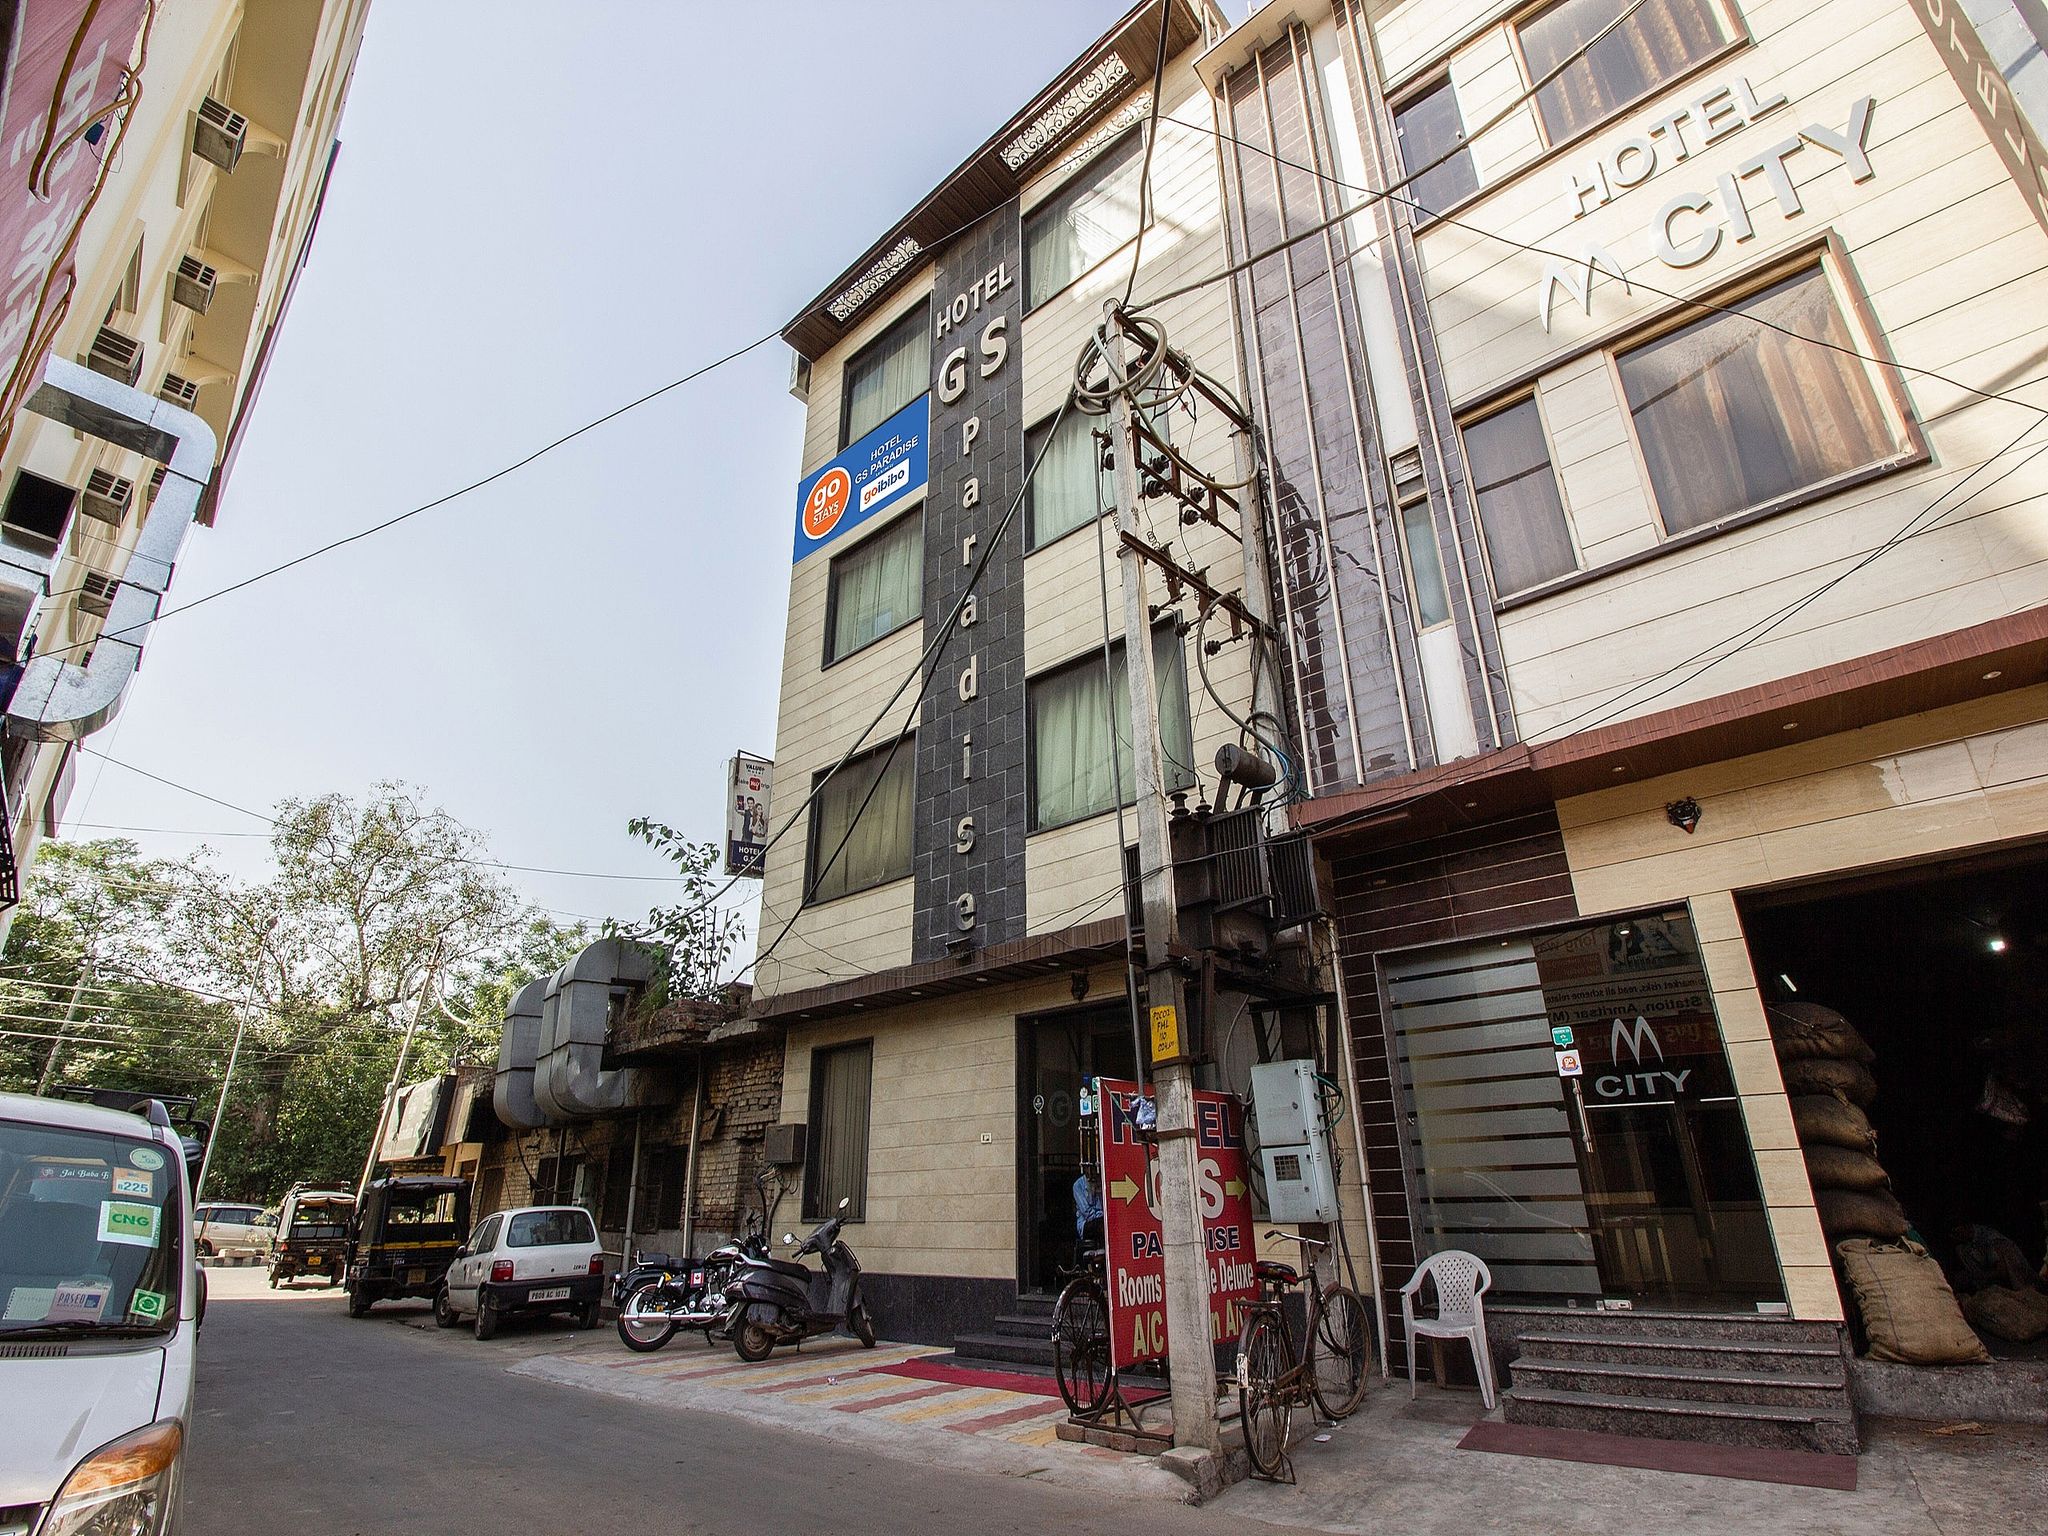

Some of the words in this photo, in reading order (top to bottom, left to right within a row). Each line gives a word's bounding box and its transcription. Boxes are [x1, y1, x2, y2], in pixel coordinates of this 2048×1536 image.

[1564, 75, 1790, 219] HOTEL
[1649, 94, 1878, 270] CITY
[936, 262, 1014, 341] HOTEL
[855, 468, 868, 485] GS
[870, 434, 919, 477] PARADISE
[870, 434, 902, 462] HOTEL
[813, 476, 841, 514] go
[863, 468, 906, 505] goibibo
[813, 500, 840, 525] STAYS
[955, 416, 980, 931] Paradise
[1594, 1068, 1692, 1099] CITY
[1110, 1091, 1244, 1150] HEL
[111, 1213, 150, 1227] CNG
[1131, 1225, 1241, 1260] PAISE
[1118, 1267, 1162, 1308] Rooms
[1218, 1257, 1254, 1293] Deluxe
[1133, 1311, 1164, 1358] A/C
